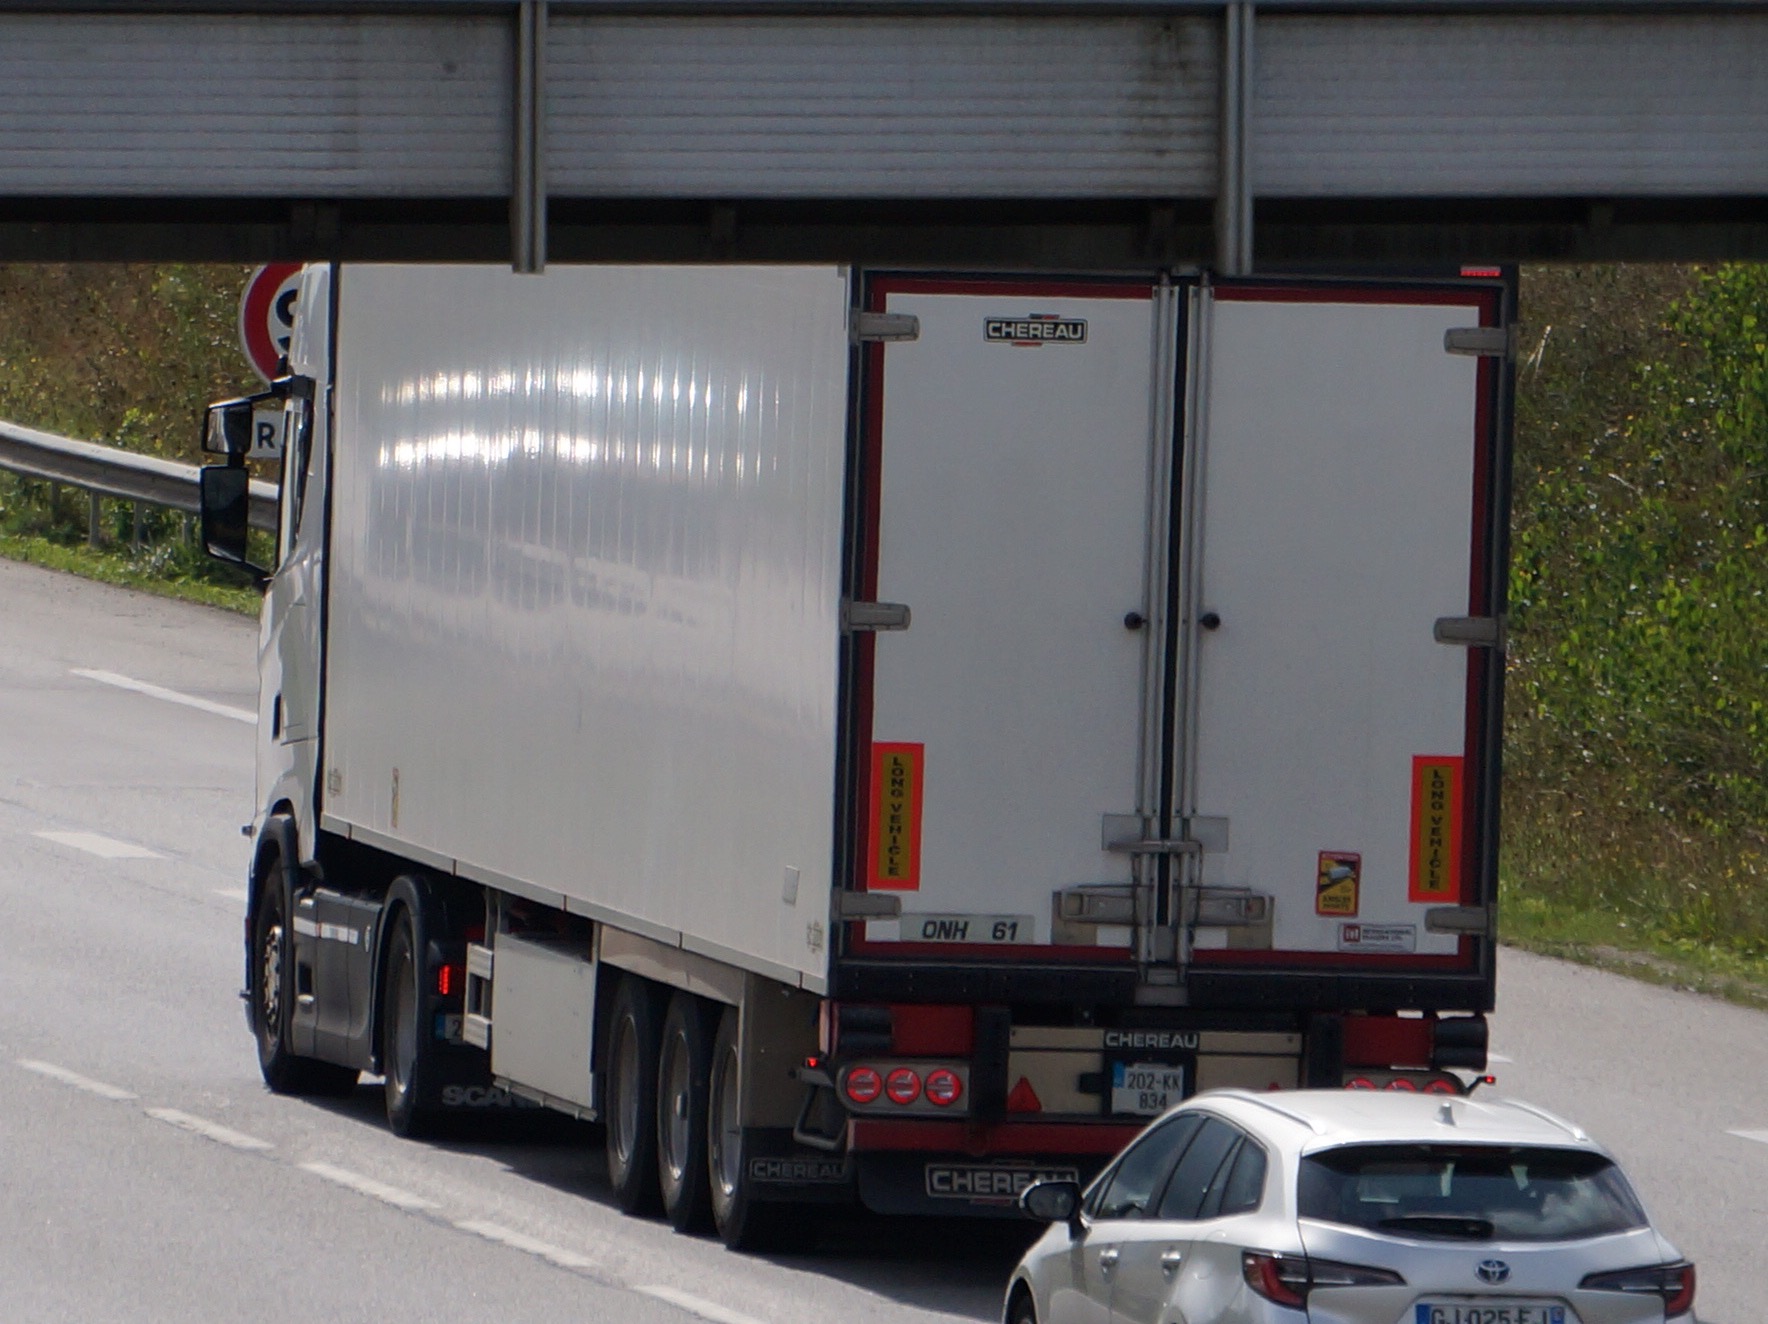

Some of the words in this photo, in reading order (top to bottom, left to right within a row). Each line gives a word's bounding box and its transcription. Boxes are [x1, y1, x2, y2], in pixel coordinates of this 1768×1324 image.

[988, 321, 1083, 339] CHEREAU
[889, 756, 905, 799] LONG
[1430, 768, 1445, 811] LONG
[887, 803, 903, 877] VEHICLE
[1428, 815, 1443, 890] VEHICLE
[922, 920, 970, 940] ONH
[992, 920, 1019, 941] 61
[1105, 1031, 1198, 1049] CHEREAU
